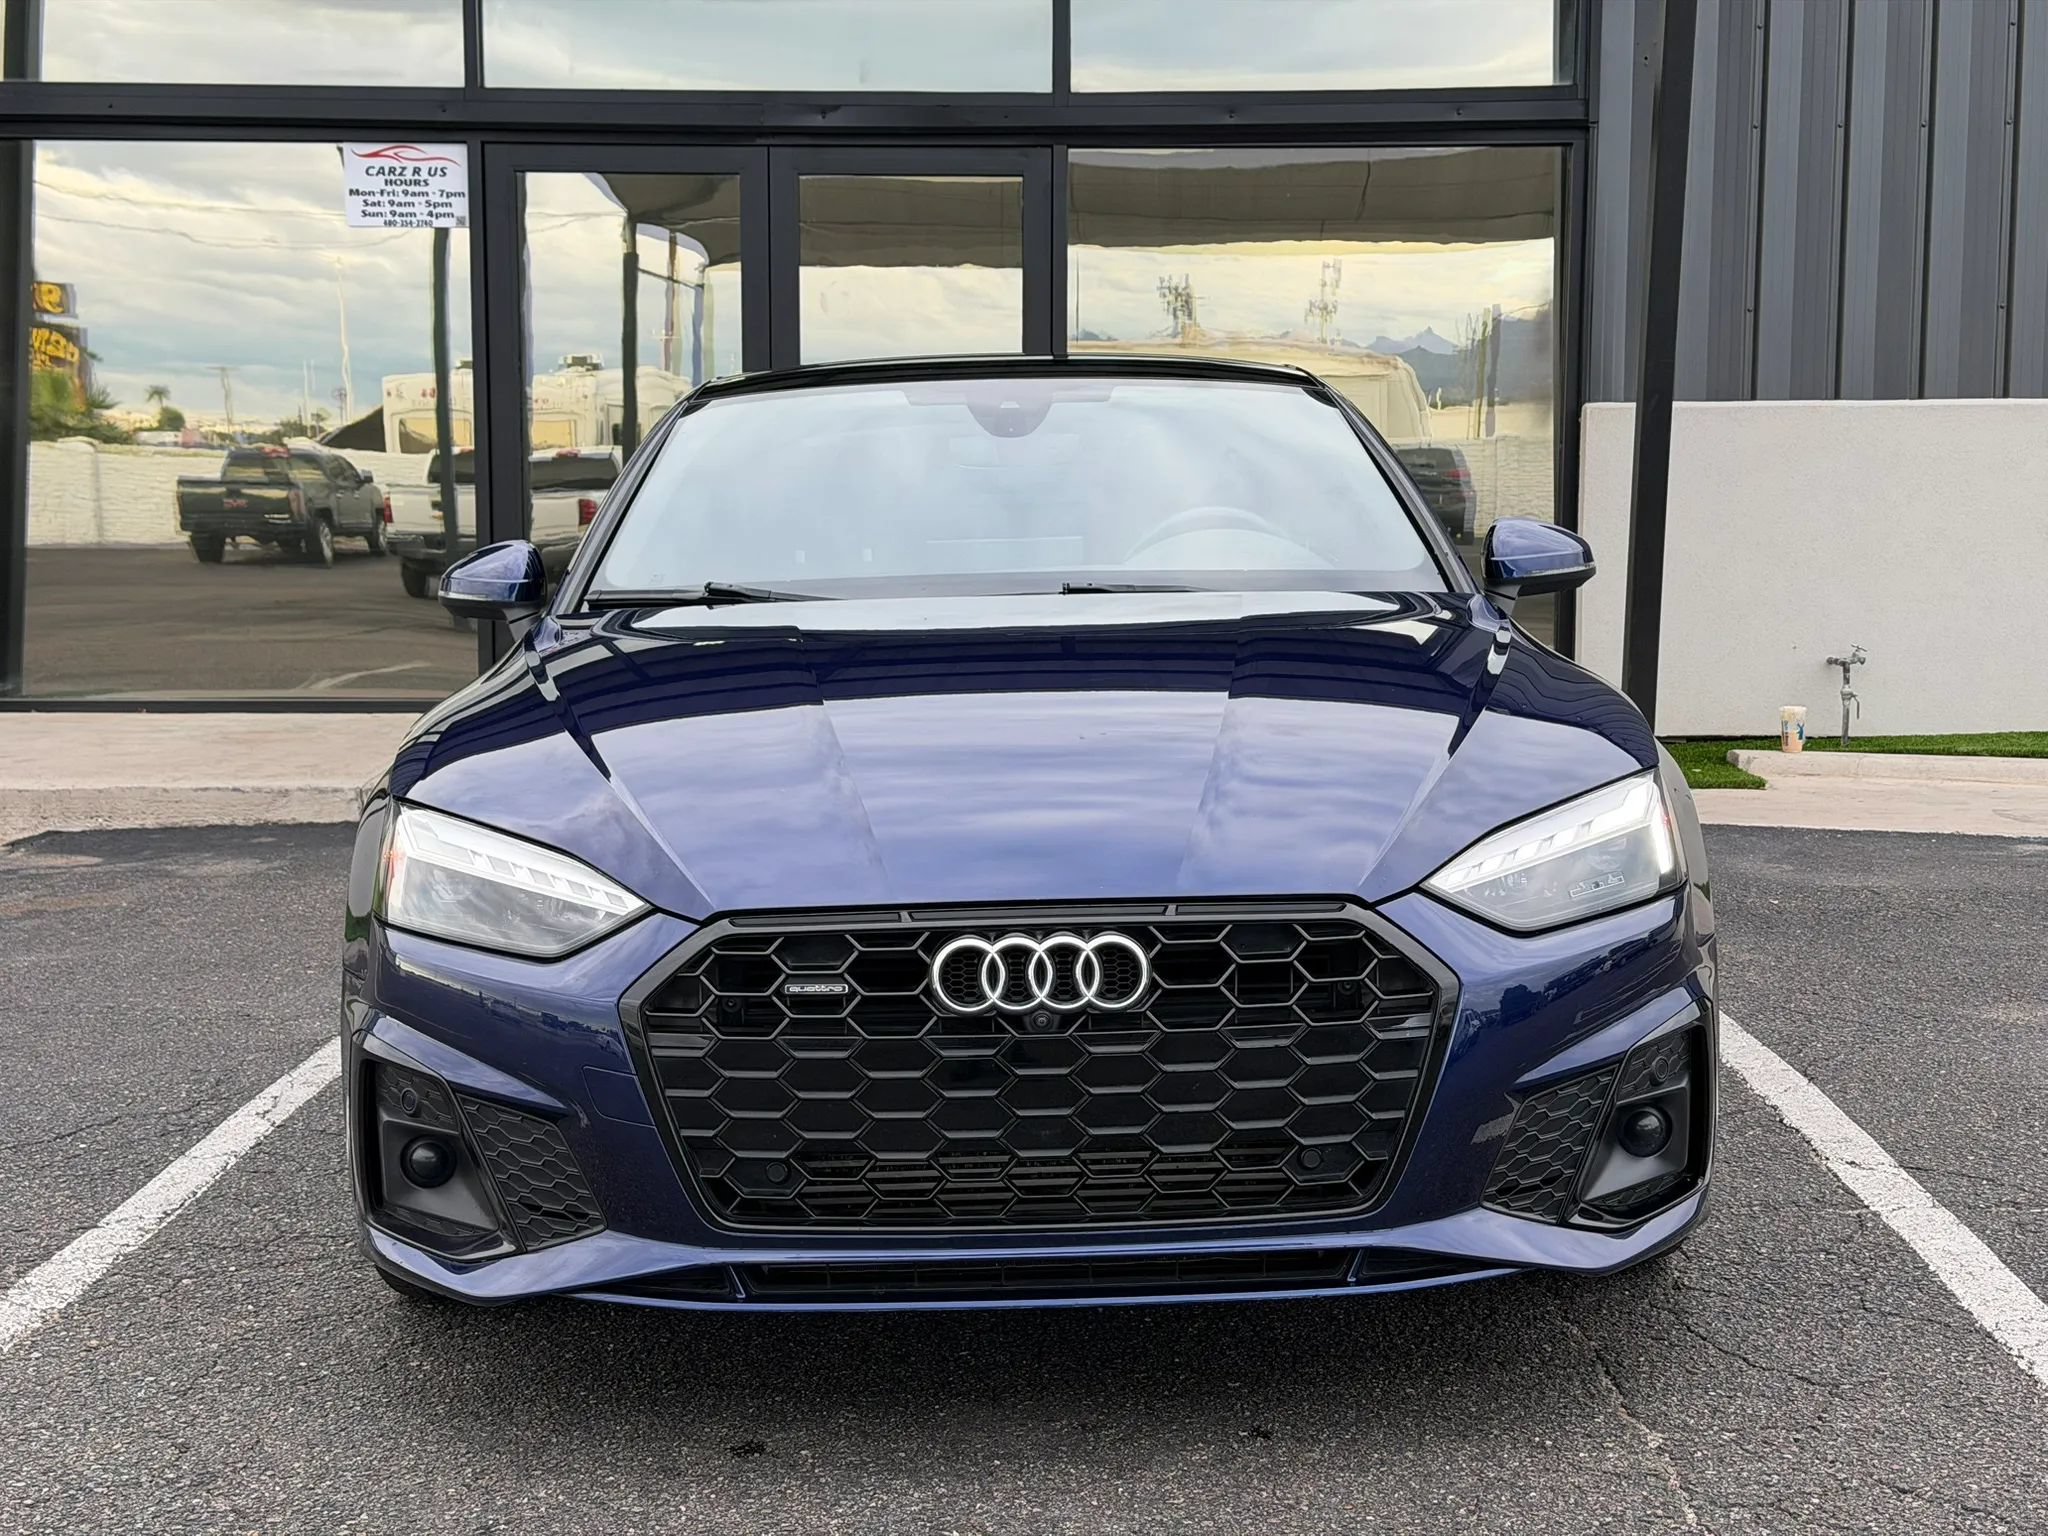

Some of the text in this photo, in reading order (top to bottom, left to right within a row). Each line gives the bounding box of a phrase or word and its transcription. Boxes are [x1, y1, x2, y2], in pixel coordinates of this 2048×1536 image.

[365, 166, 448, 177] CARZ R US
[384, 178, 430, 187] HOURS
[349, 189, 399, 197] Mon-Fri:
[402, 189, 429, 197] 9am
[438, 189, 466, 199] 7pm
[362, 199, 385, 208] Sat:
[388, 199, 415, 208] 9am
[424, 199, 453, 209] 5pm
[361, 209, 387, 218] Sun:
[389, 209, 417, 218] 9am
[427, 210, 454, 220] 4pm
